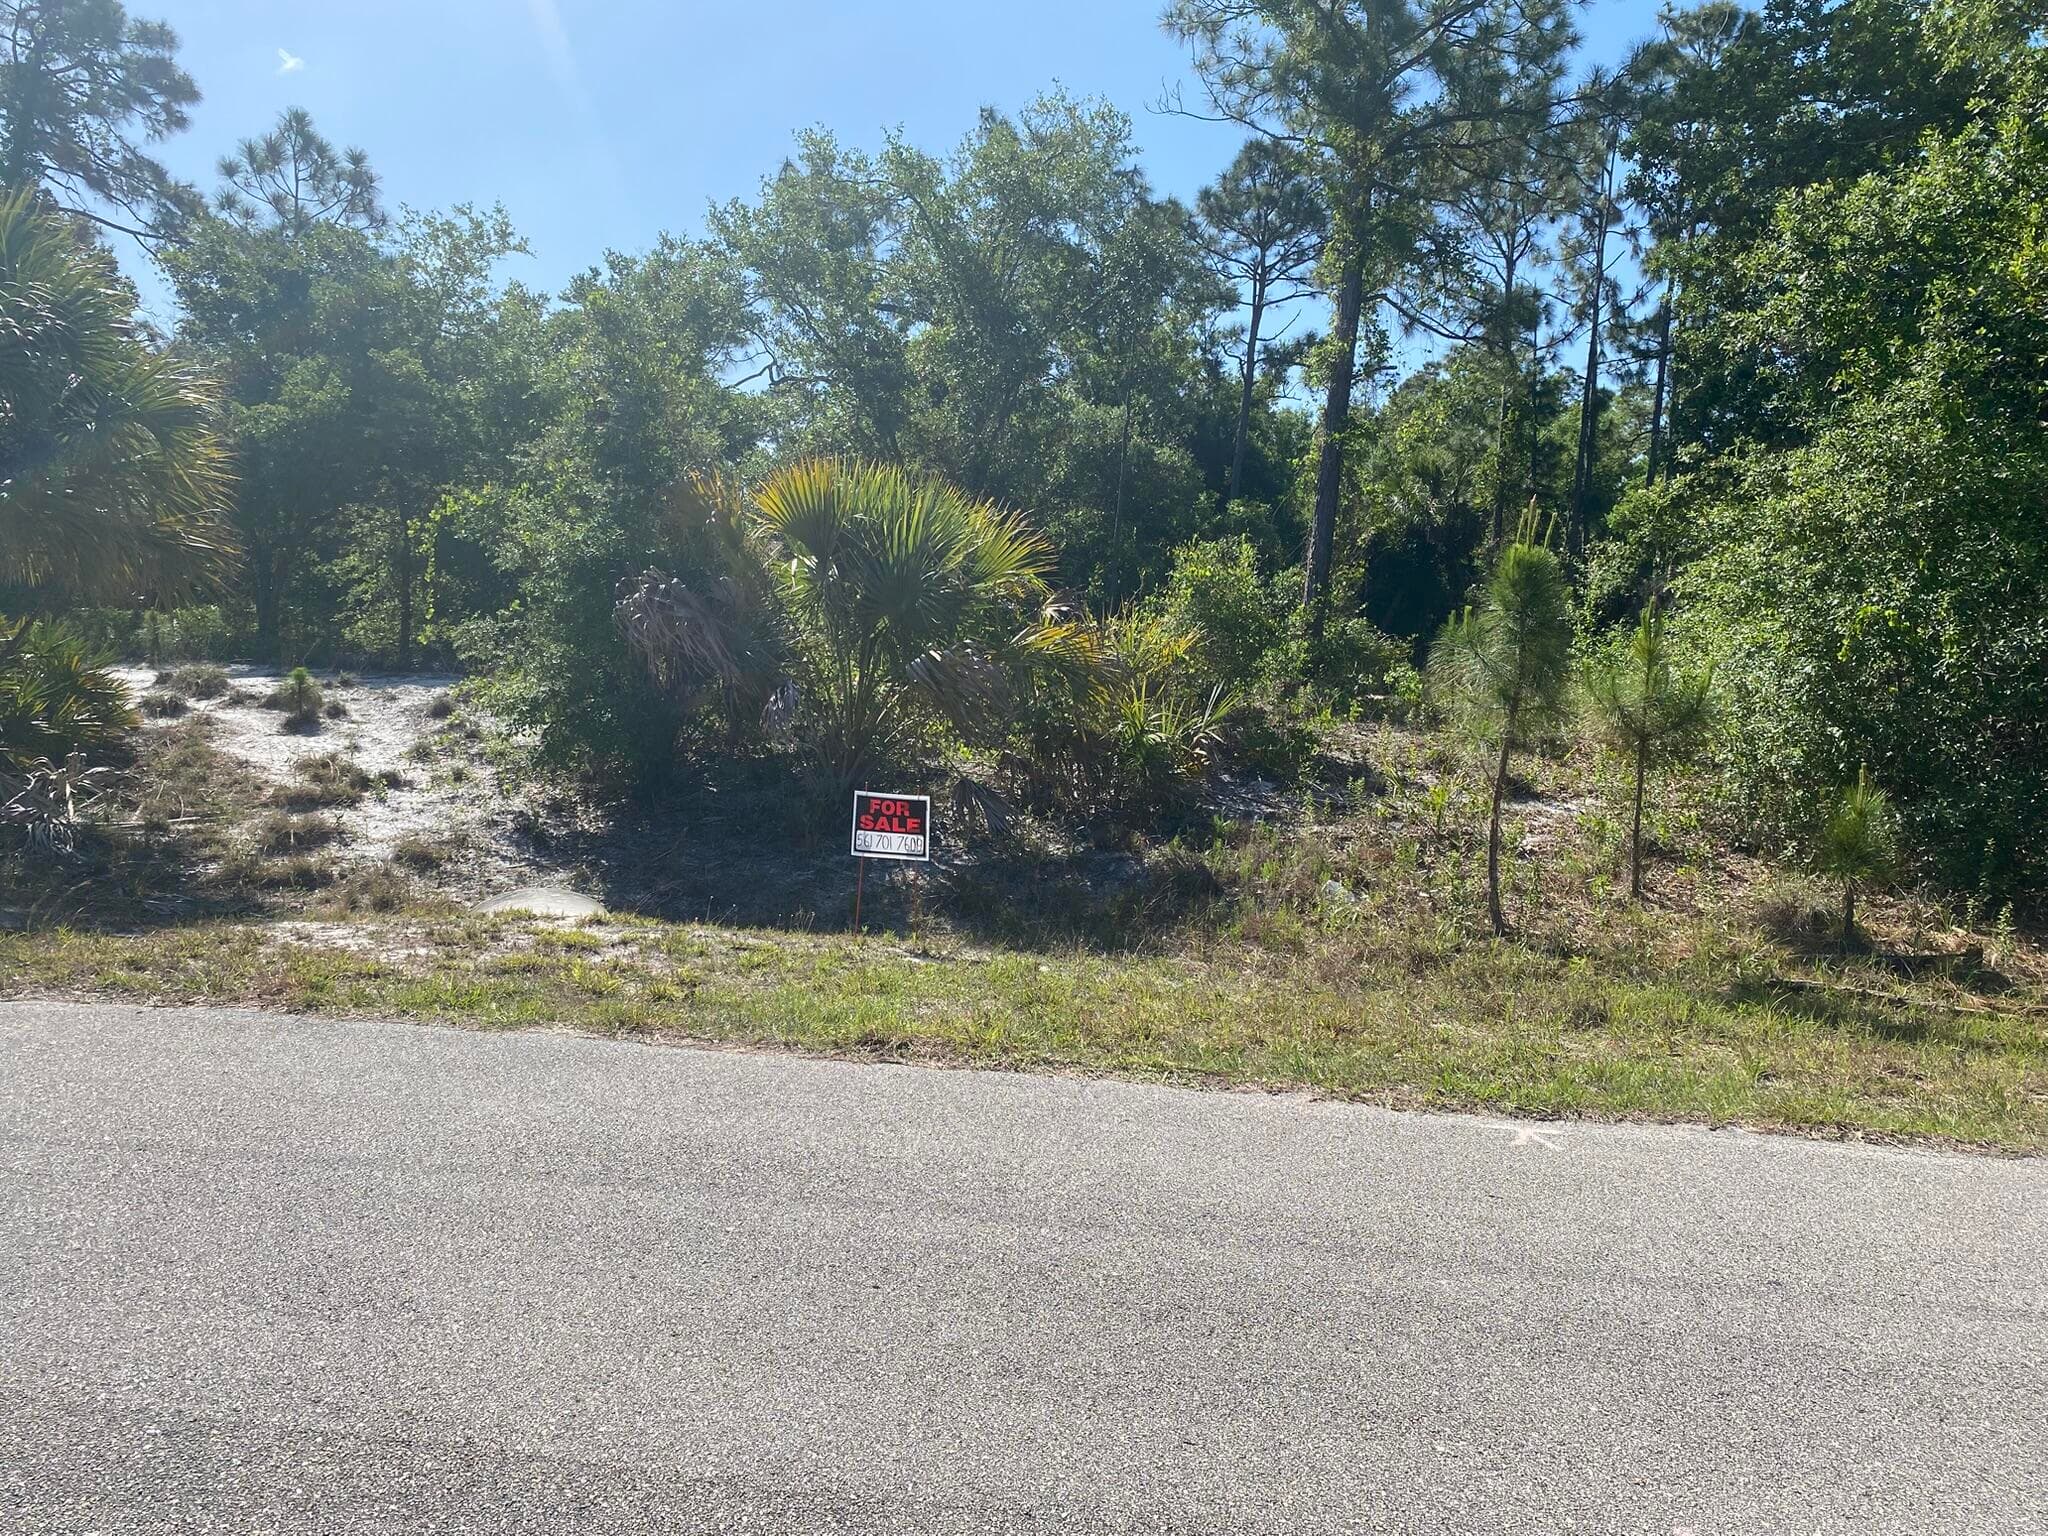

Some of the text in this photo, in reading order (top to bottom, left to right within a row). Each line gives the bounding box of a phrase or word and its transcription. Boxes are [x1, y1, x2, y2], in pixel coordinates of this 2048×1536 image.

[870, 799, 910, 816] FOR
[860, 815, 920, 832] SALE
[857, 833, 872, 848] 561
[876, 835, 892, 849] 701
